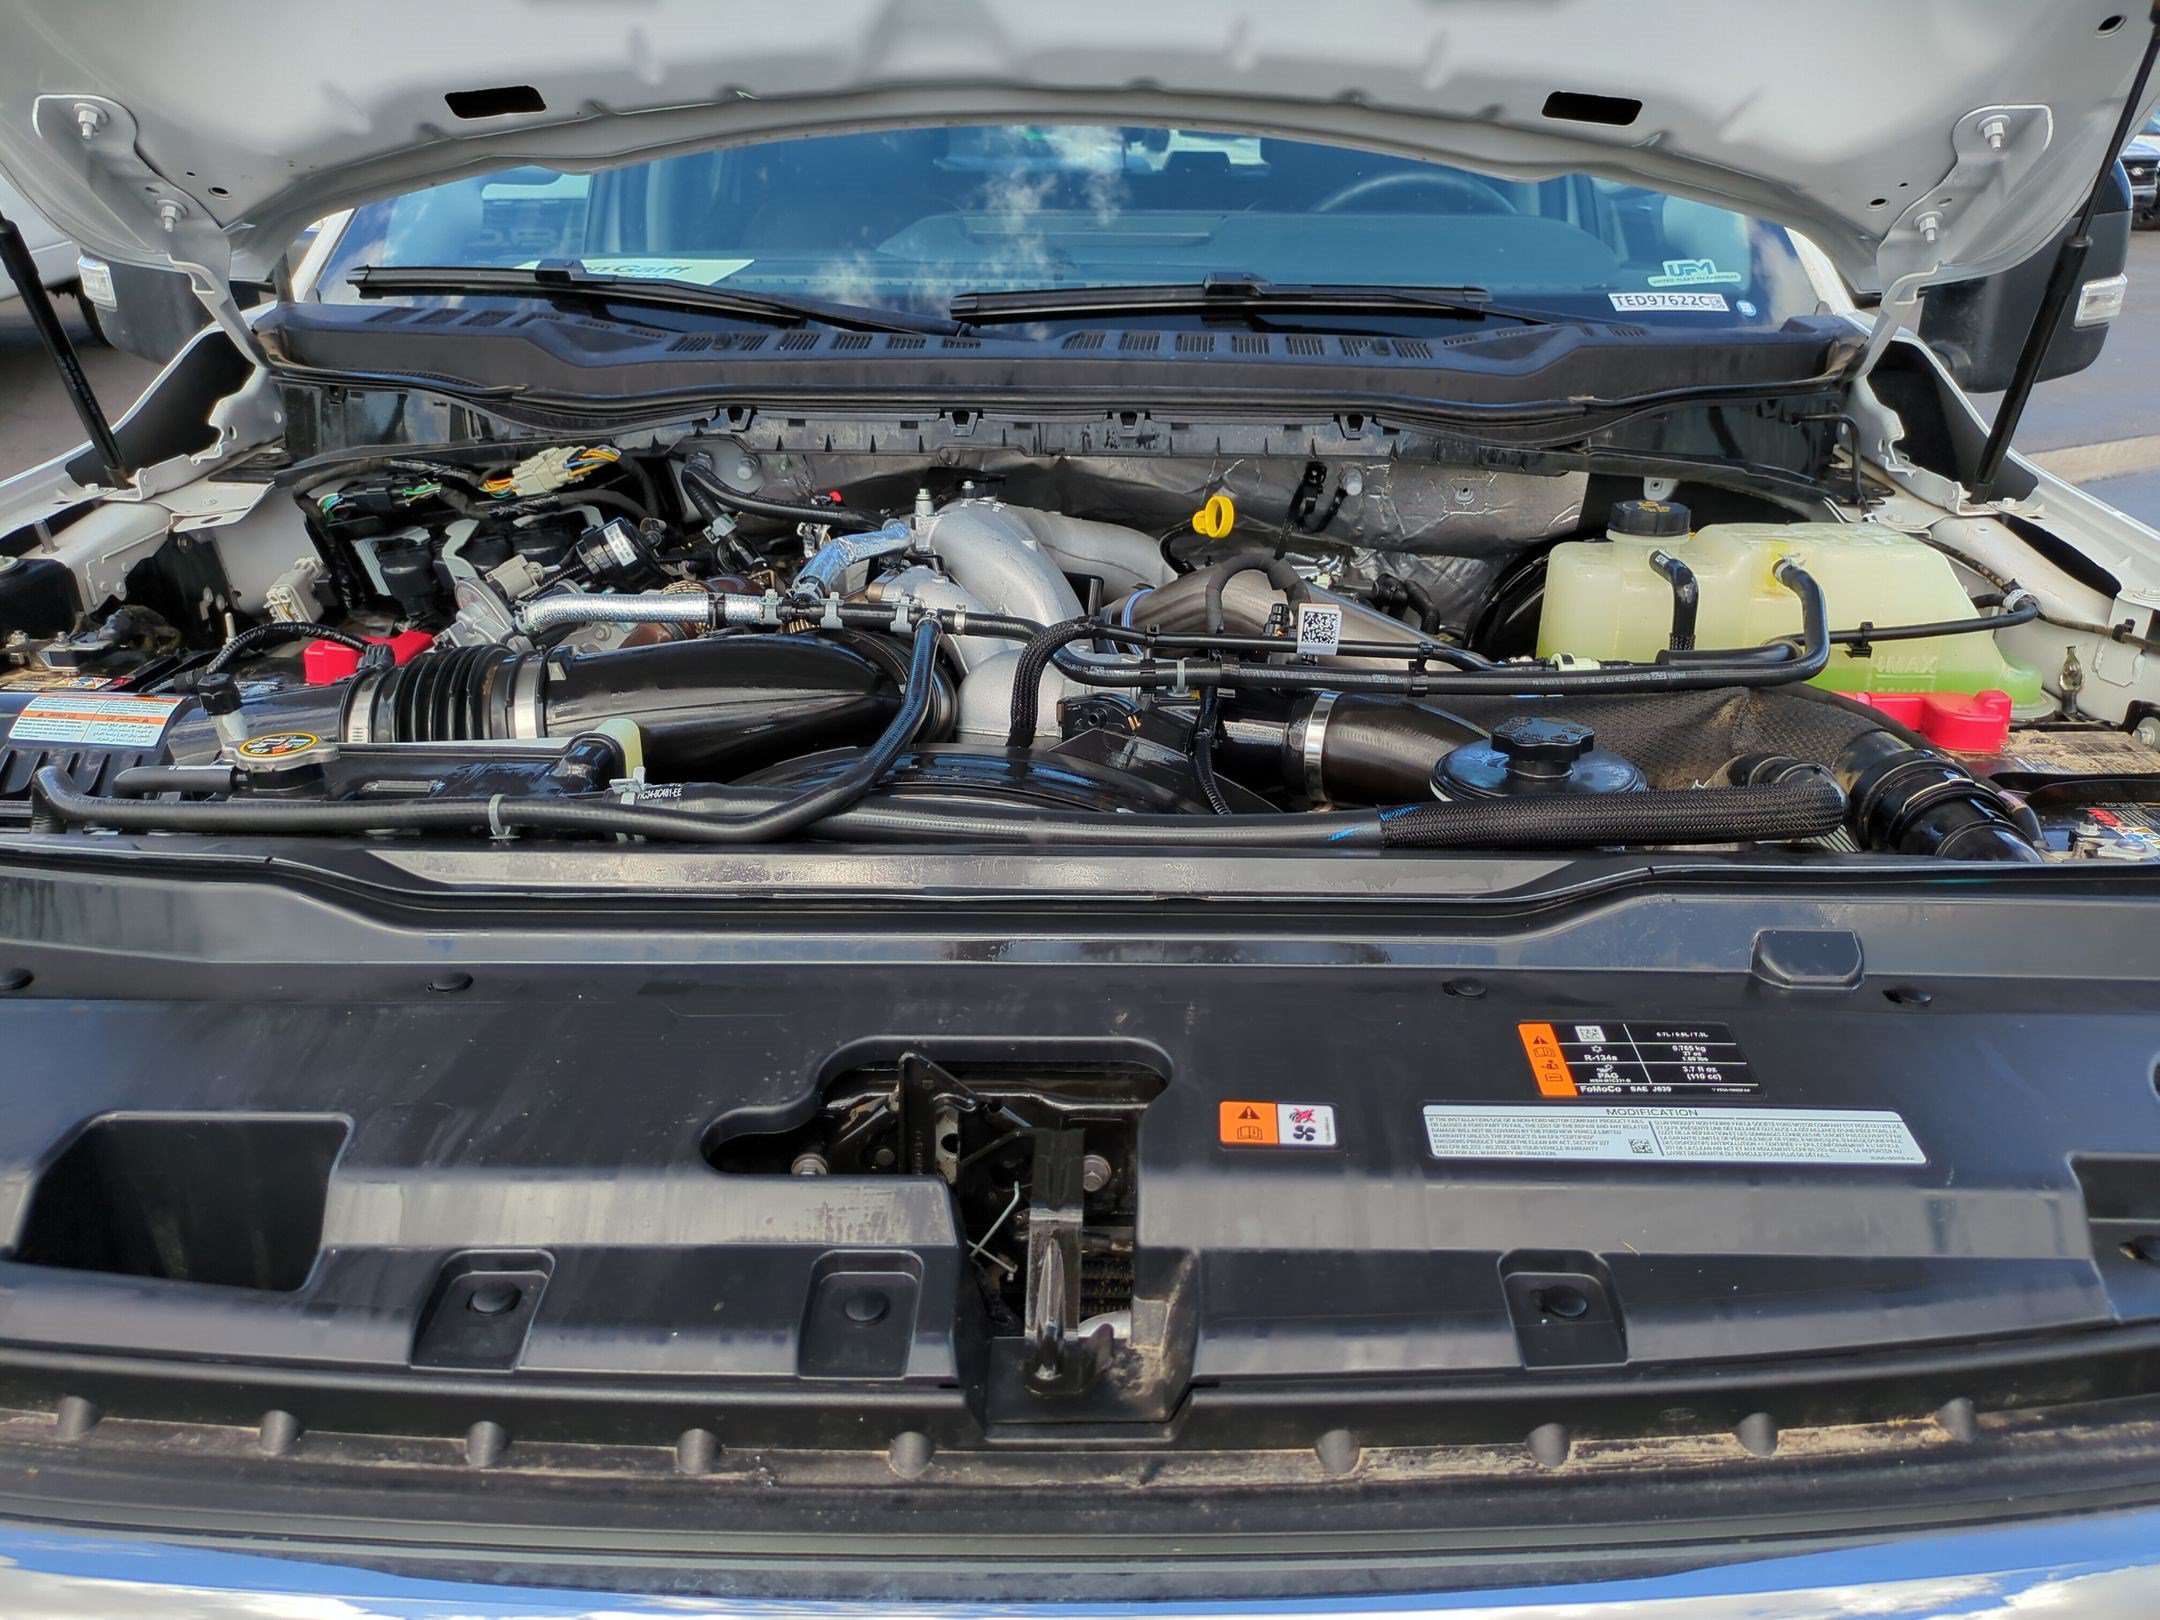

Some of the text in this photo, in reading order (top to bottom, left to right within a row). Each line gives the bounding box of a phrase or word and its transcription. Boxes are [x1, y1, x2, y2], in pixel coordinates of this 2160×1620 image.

[1667, 262, 1714, 276] UFM
[1612, 295, 1710, 306] TED97622C
[1886, 656, 1936, 674] MAX
[1606, 1108, 1698, 1116] MODIFICATION
